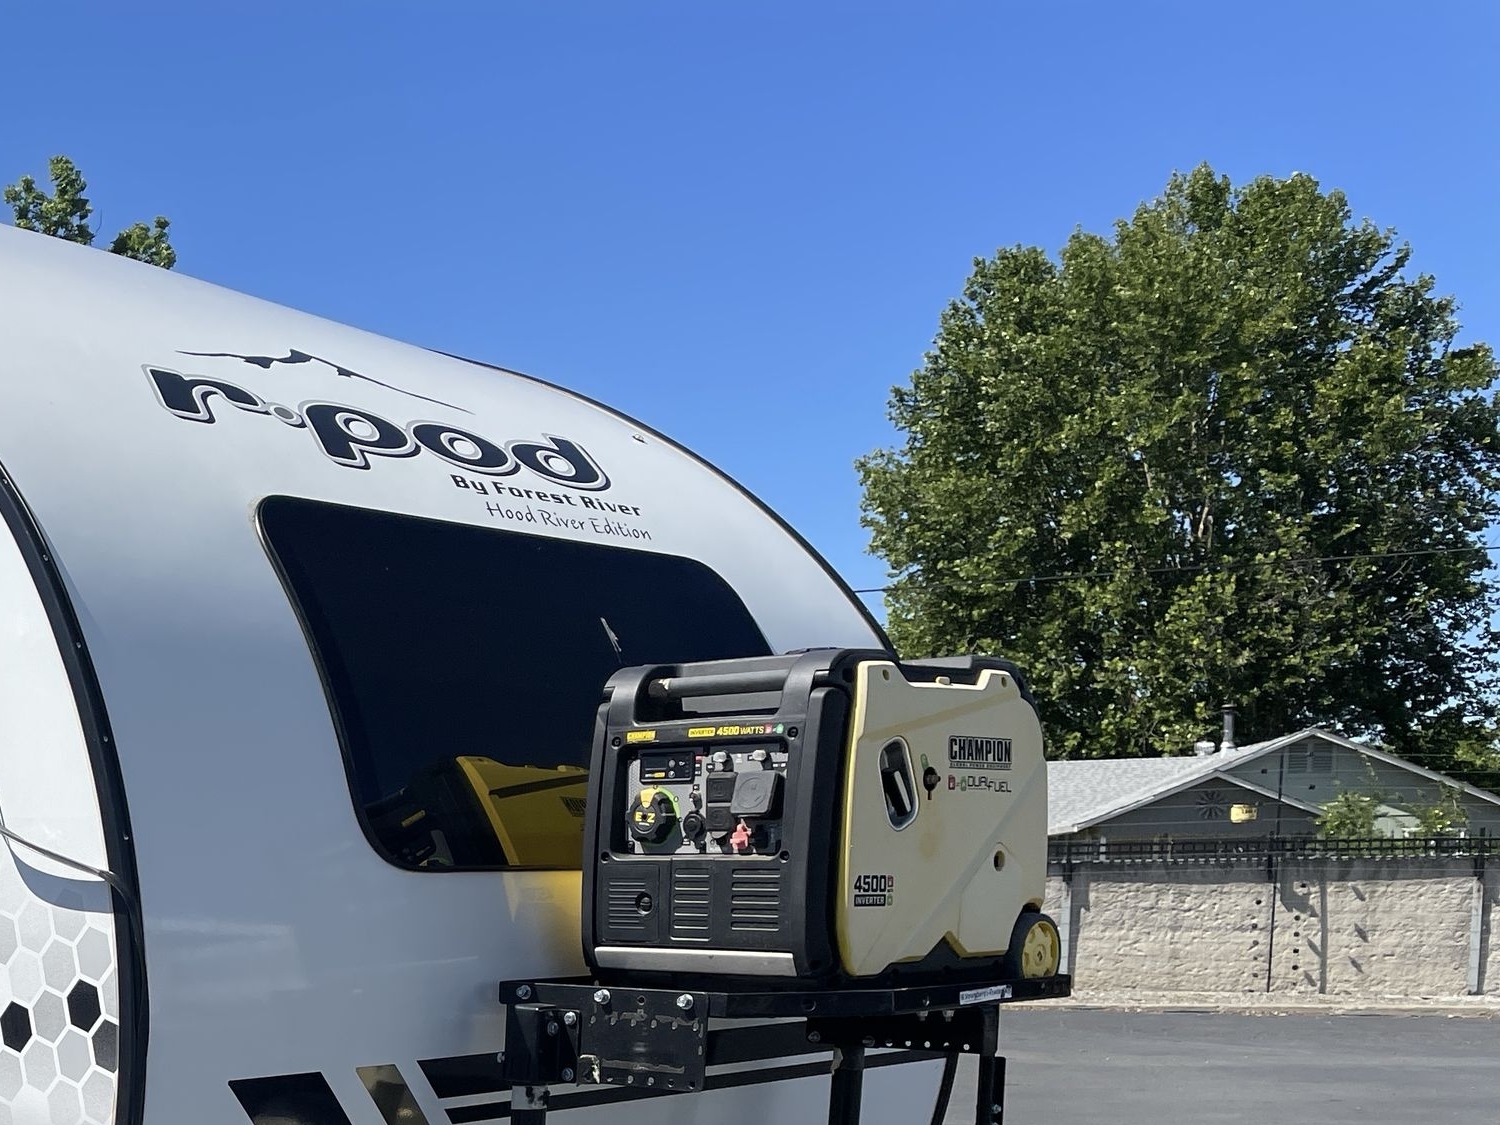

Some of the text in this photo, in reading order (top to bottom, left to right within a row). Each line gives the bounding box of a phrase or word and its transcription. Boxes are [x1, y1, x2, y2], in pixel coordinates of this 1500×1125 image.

[450, 474, 641, 517] By Forest River
[486, 501, 652, 540] Hood River Edition
[716, 726, 740, 735] 4500
[740, 725, 765, 735] WATTS
[949, 738, 1012, 763] CHAMPION
[854, 874, 887, 893] 4500
